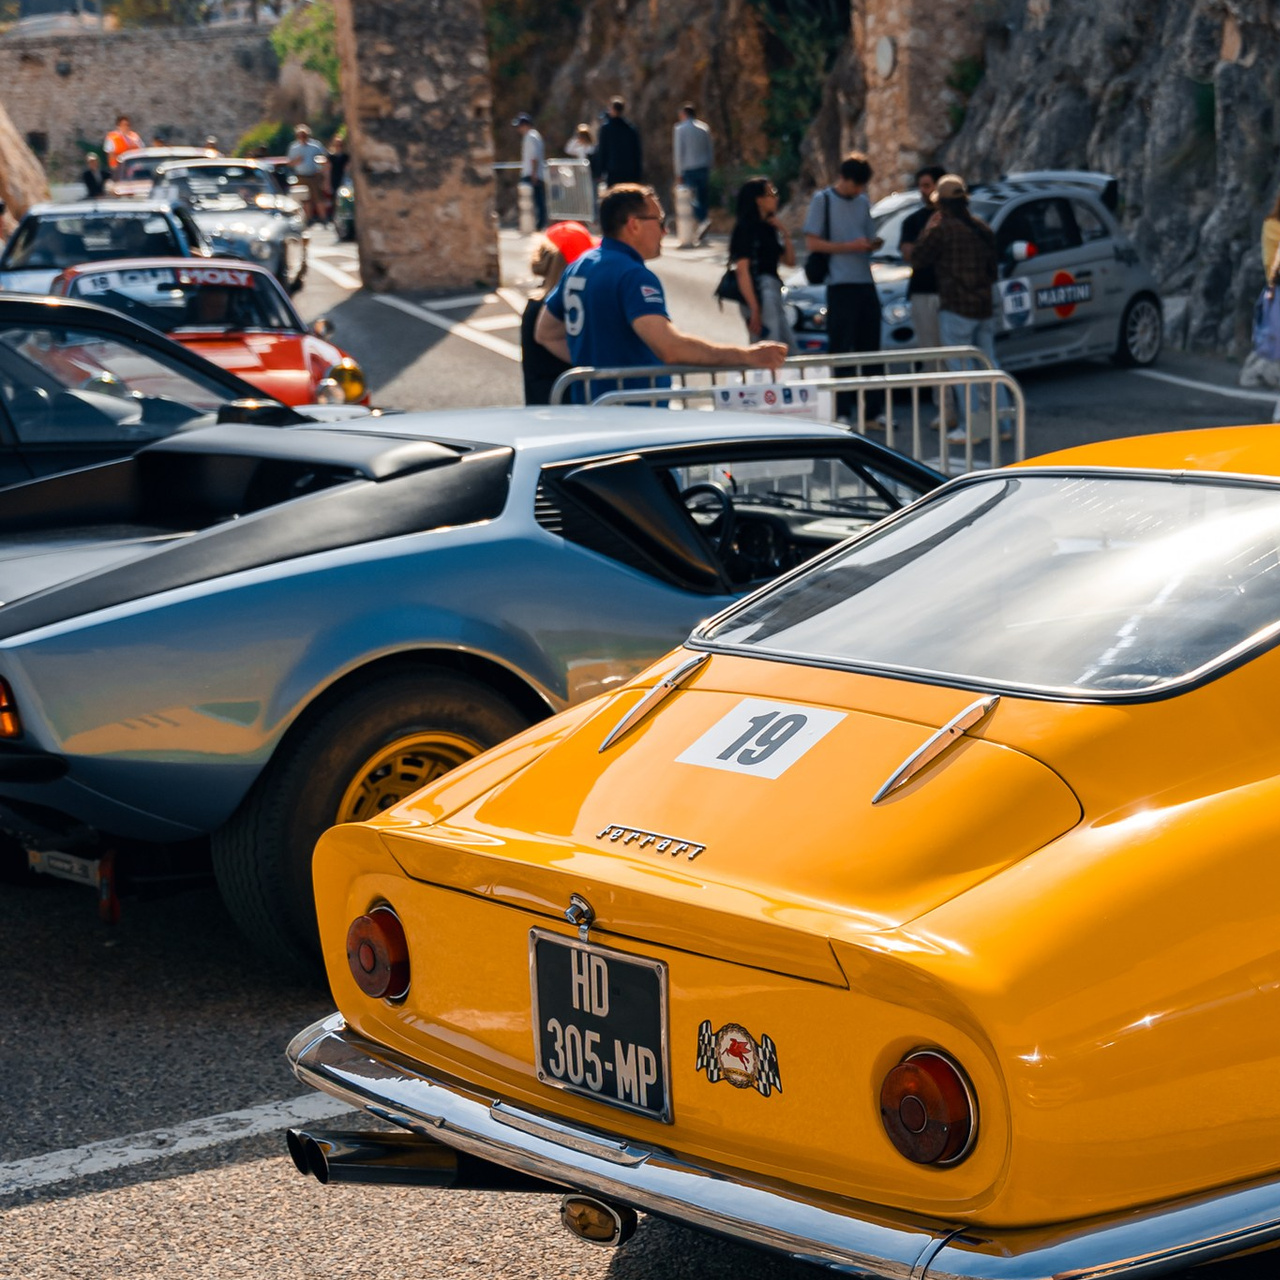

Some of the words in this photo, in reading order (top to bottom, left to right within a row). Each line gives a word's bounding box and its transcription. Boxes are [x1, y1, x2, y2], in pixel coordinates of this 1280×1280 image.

[178, 269, 250, 285] MOLY
[1038, 284, 1090, 306] MARTINI
[563, 276, 587, 336] 5
[716, 711, 808, 766] 19
[570, 949, 609, 1018] HD
[547, 1017, 658, 1108] 305-MP
